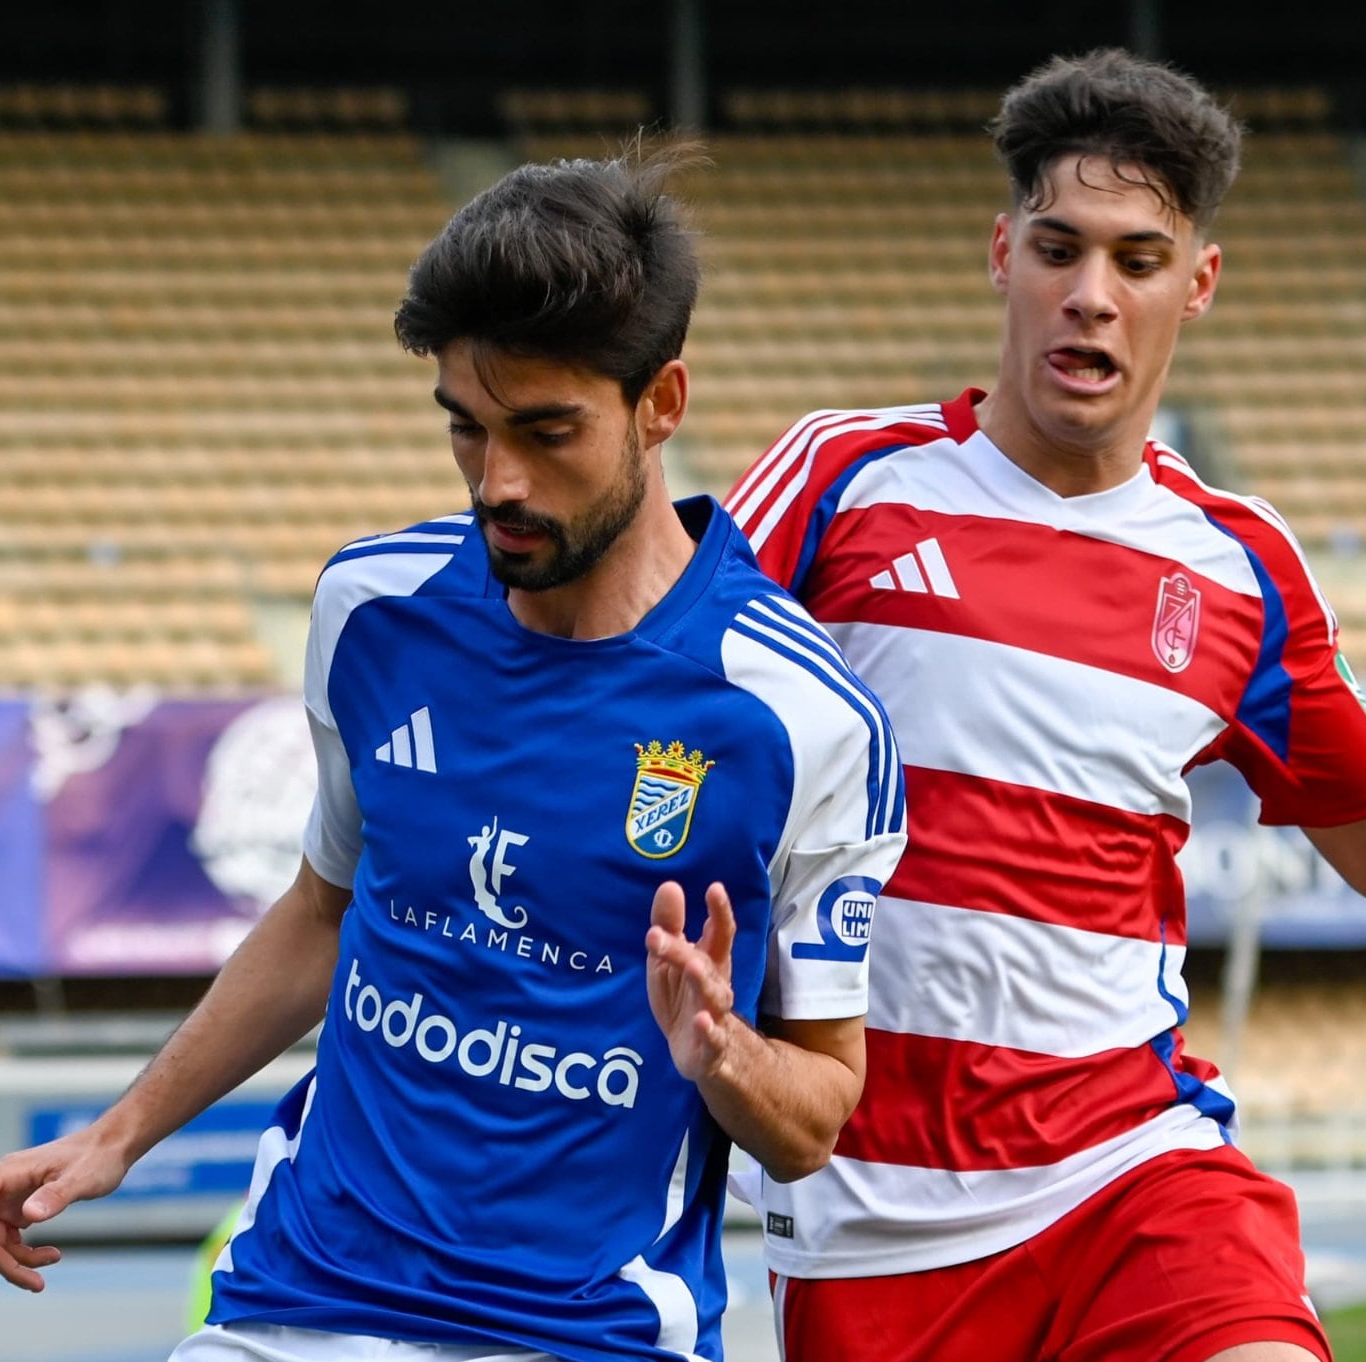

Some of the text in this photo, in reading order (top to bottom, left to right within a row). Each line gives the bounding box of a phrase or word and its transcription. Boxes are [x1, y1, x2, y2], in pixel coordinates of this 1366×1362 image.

[635, 787, 691, 834] XEREZ
[843, 901, 873, 919] UNI
[390, 898, 614, 975] LAFLAMENCA
[842, 920, 870, 938] LIM
